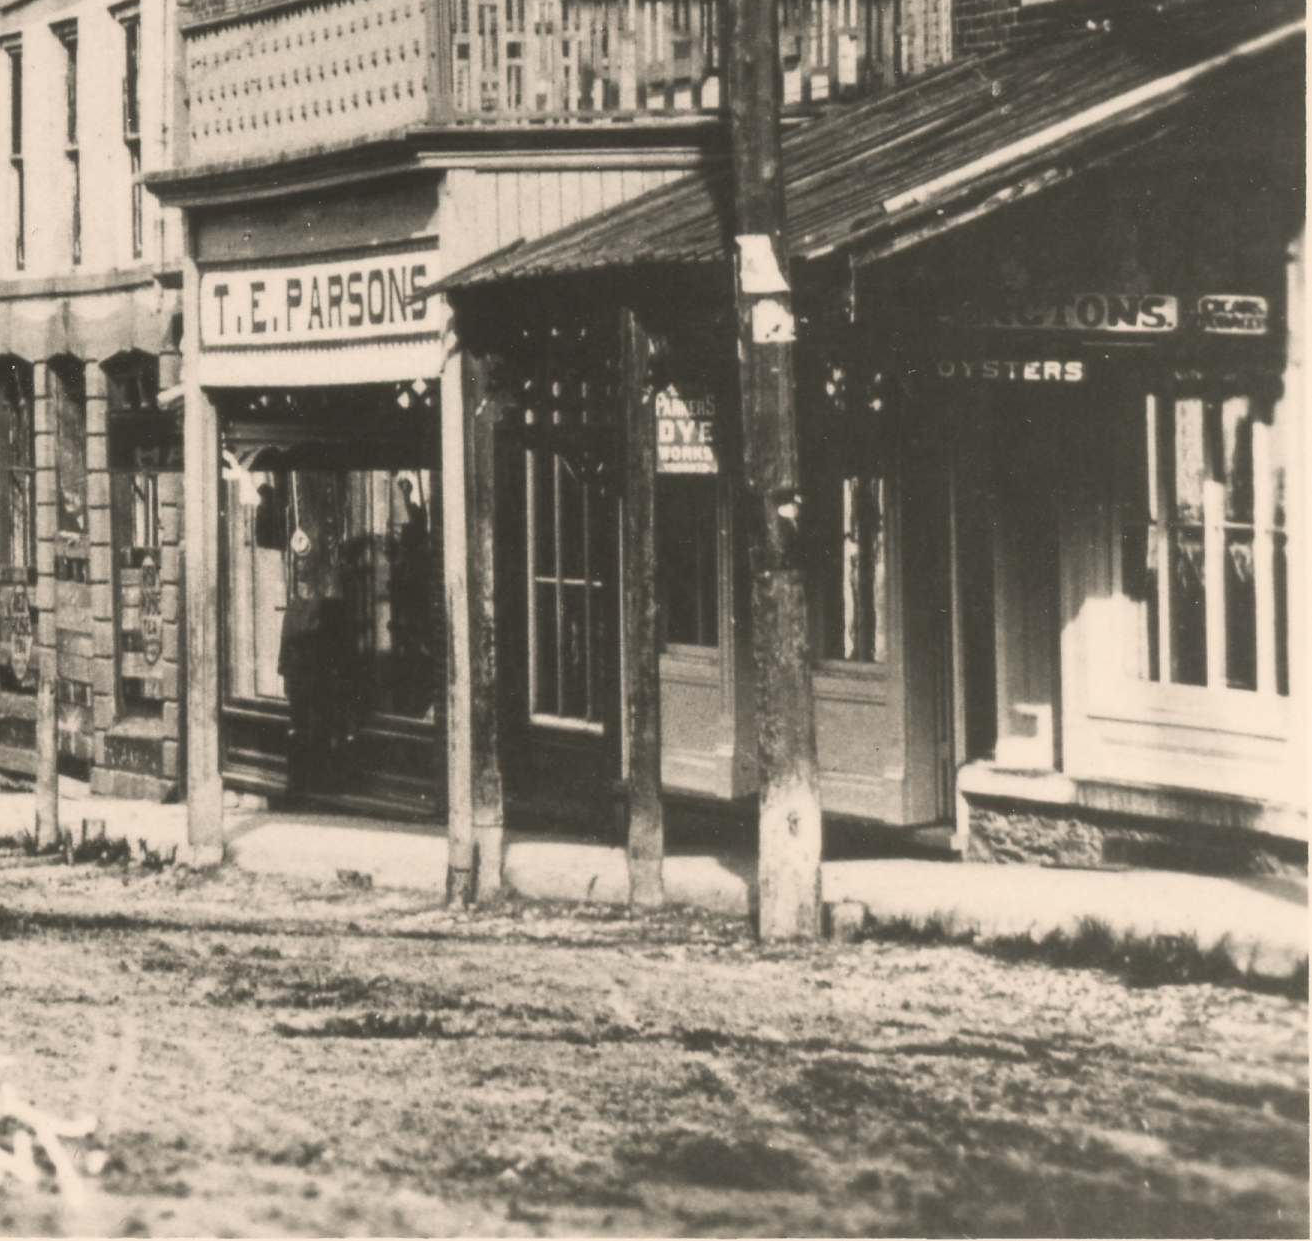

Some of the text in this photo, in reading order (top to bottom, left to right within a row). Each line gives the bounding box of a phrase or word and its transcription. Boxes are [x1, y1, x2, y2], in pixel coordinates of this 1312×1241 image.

[285, 263, 428, 333] PARSONS
[937, 360, 1084, 382] OYSTERS
[657, 419, 714, 444] DYE
[657, 444, 714, 462] WORKS
